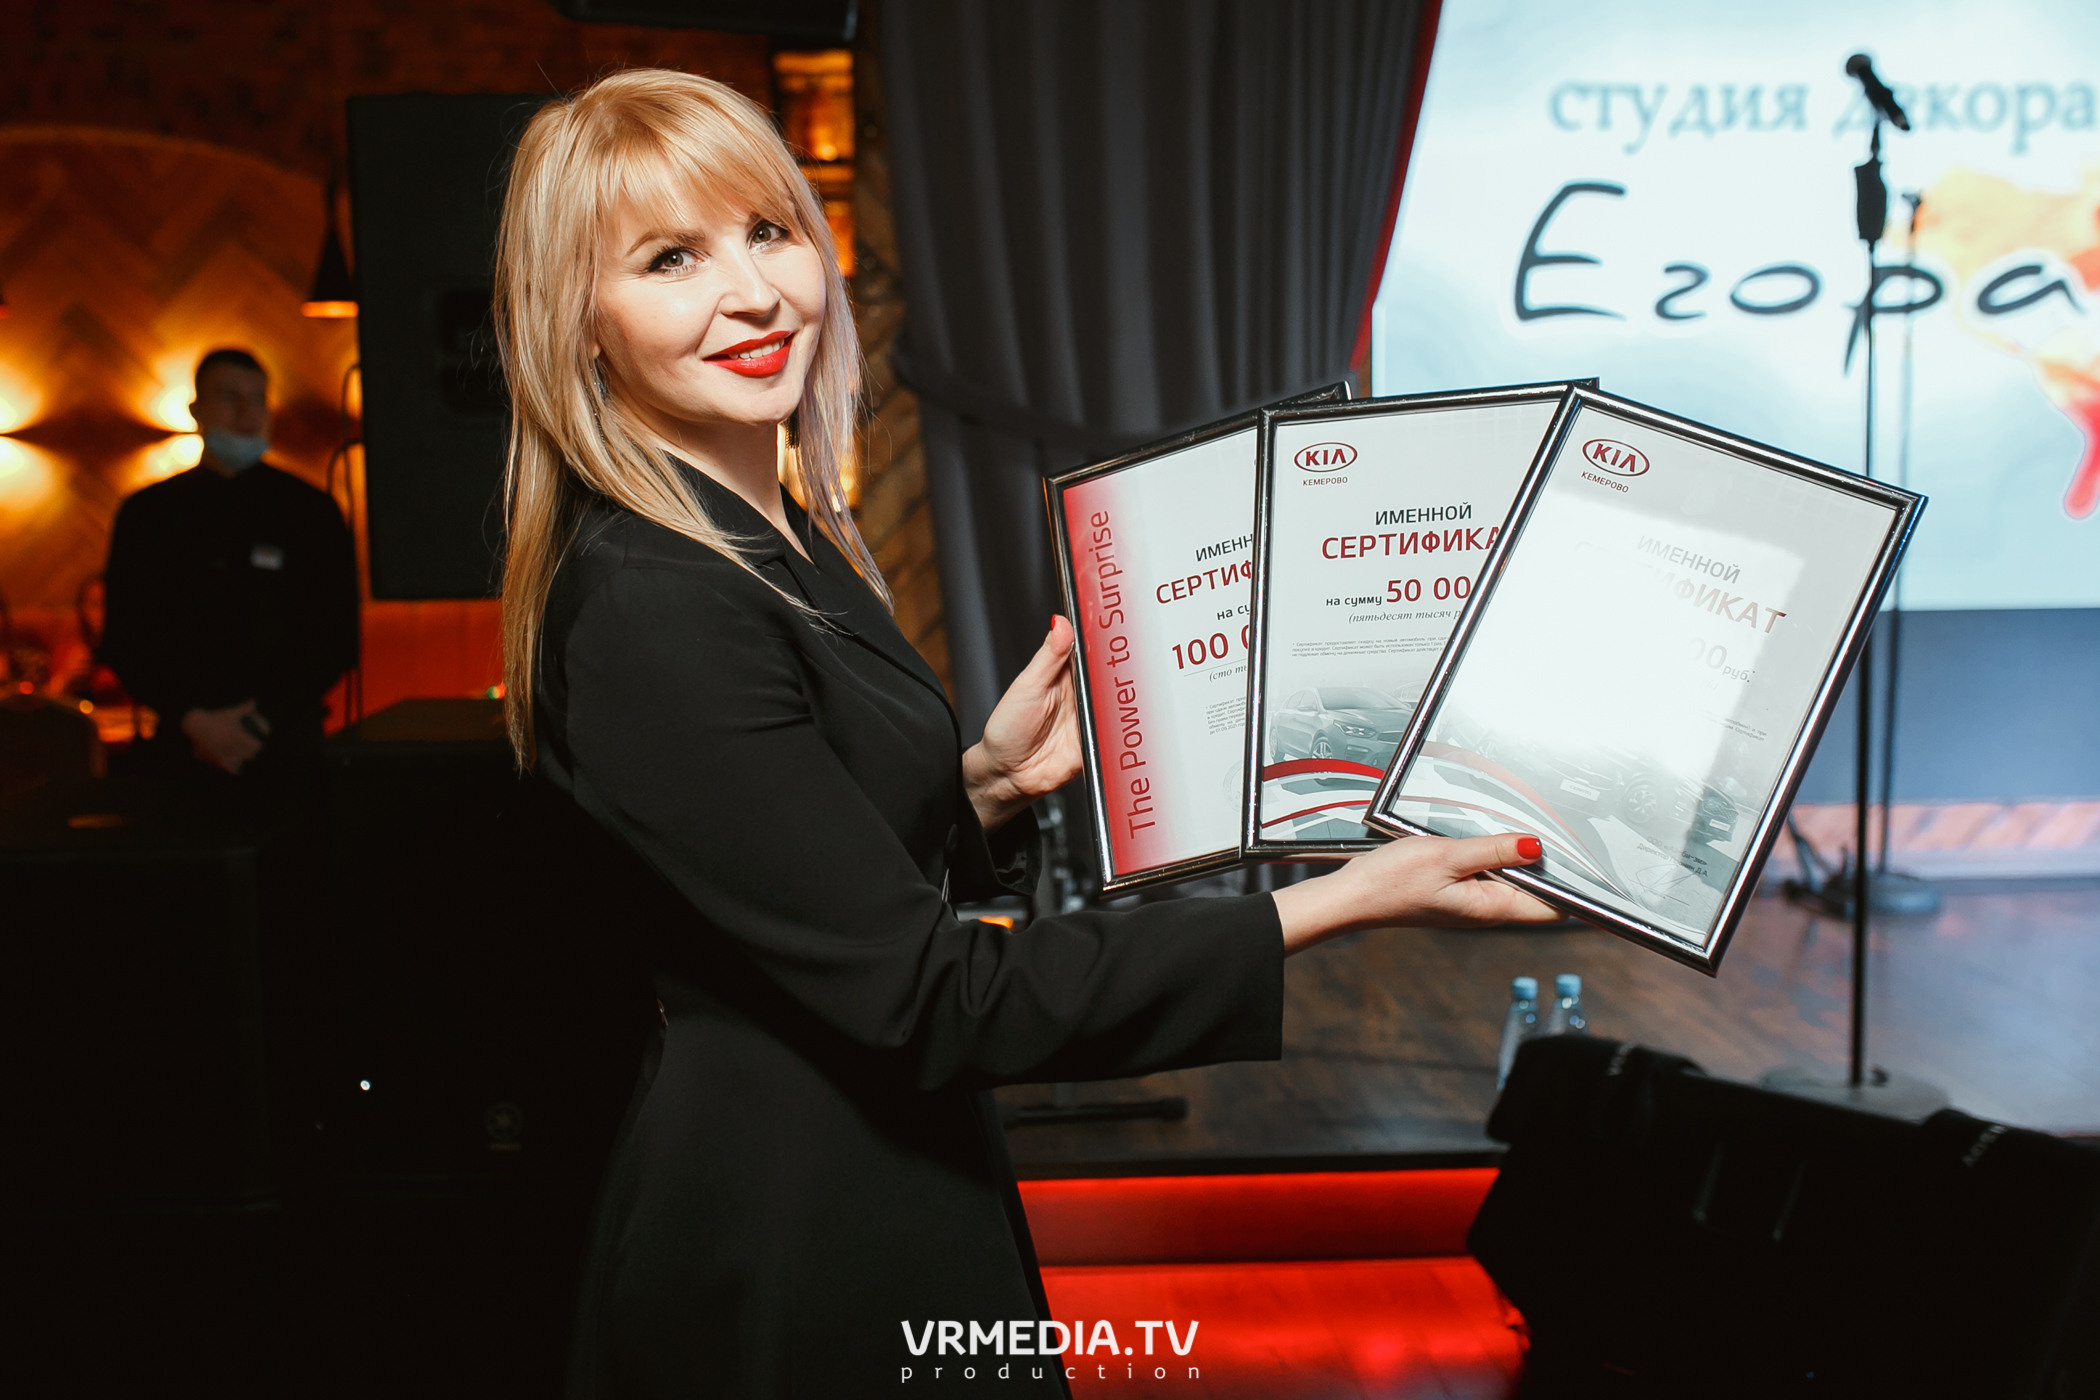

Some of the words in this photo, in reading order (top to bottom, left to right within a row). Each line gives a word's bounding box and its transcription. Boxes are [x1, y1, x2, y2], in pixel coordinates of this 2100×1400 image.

[1547, 80, 1810, 155] студия
[1831, 79, 2100, 156] дкора
[1513, 179, 2088, 376] Егора
[1304, 448, 1347, 467] KIA
[1592, 443, 1637, 473] KIA
[1302, 476, 1348, 487] КЕМЕРОВО
[1581, 471, 1629, 493] КЕМЕРОВО
[1375, 502, 1472, 526] ИМЕННОЙ
[1088, 510, 1126, 630] Surprise
[1636, 535, 1741, 584] ИМЕННОЙ
[1326, 597, 1341, 607] на
[1344, 595, 1382, 608] сумму
[1386, 579, 1422, 603] 50
[1217, 609, 1233, 620] на
[1348, 612, 1412, 625] (пятьдесят
[1415, 610, 1451, 619] тысяч
[1106, 635, 1130, 668] to
[1171, 632, 1229, 670] 100
[1114, 676, 1147, 772] Power
[1130, 776, 1156, 839] The
